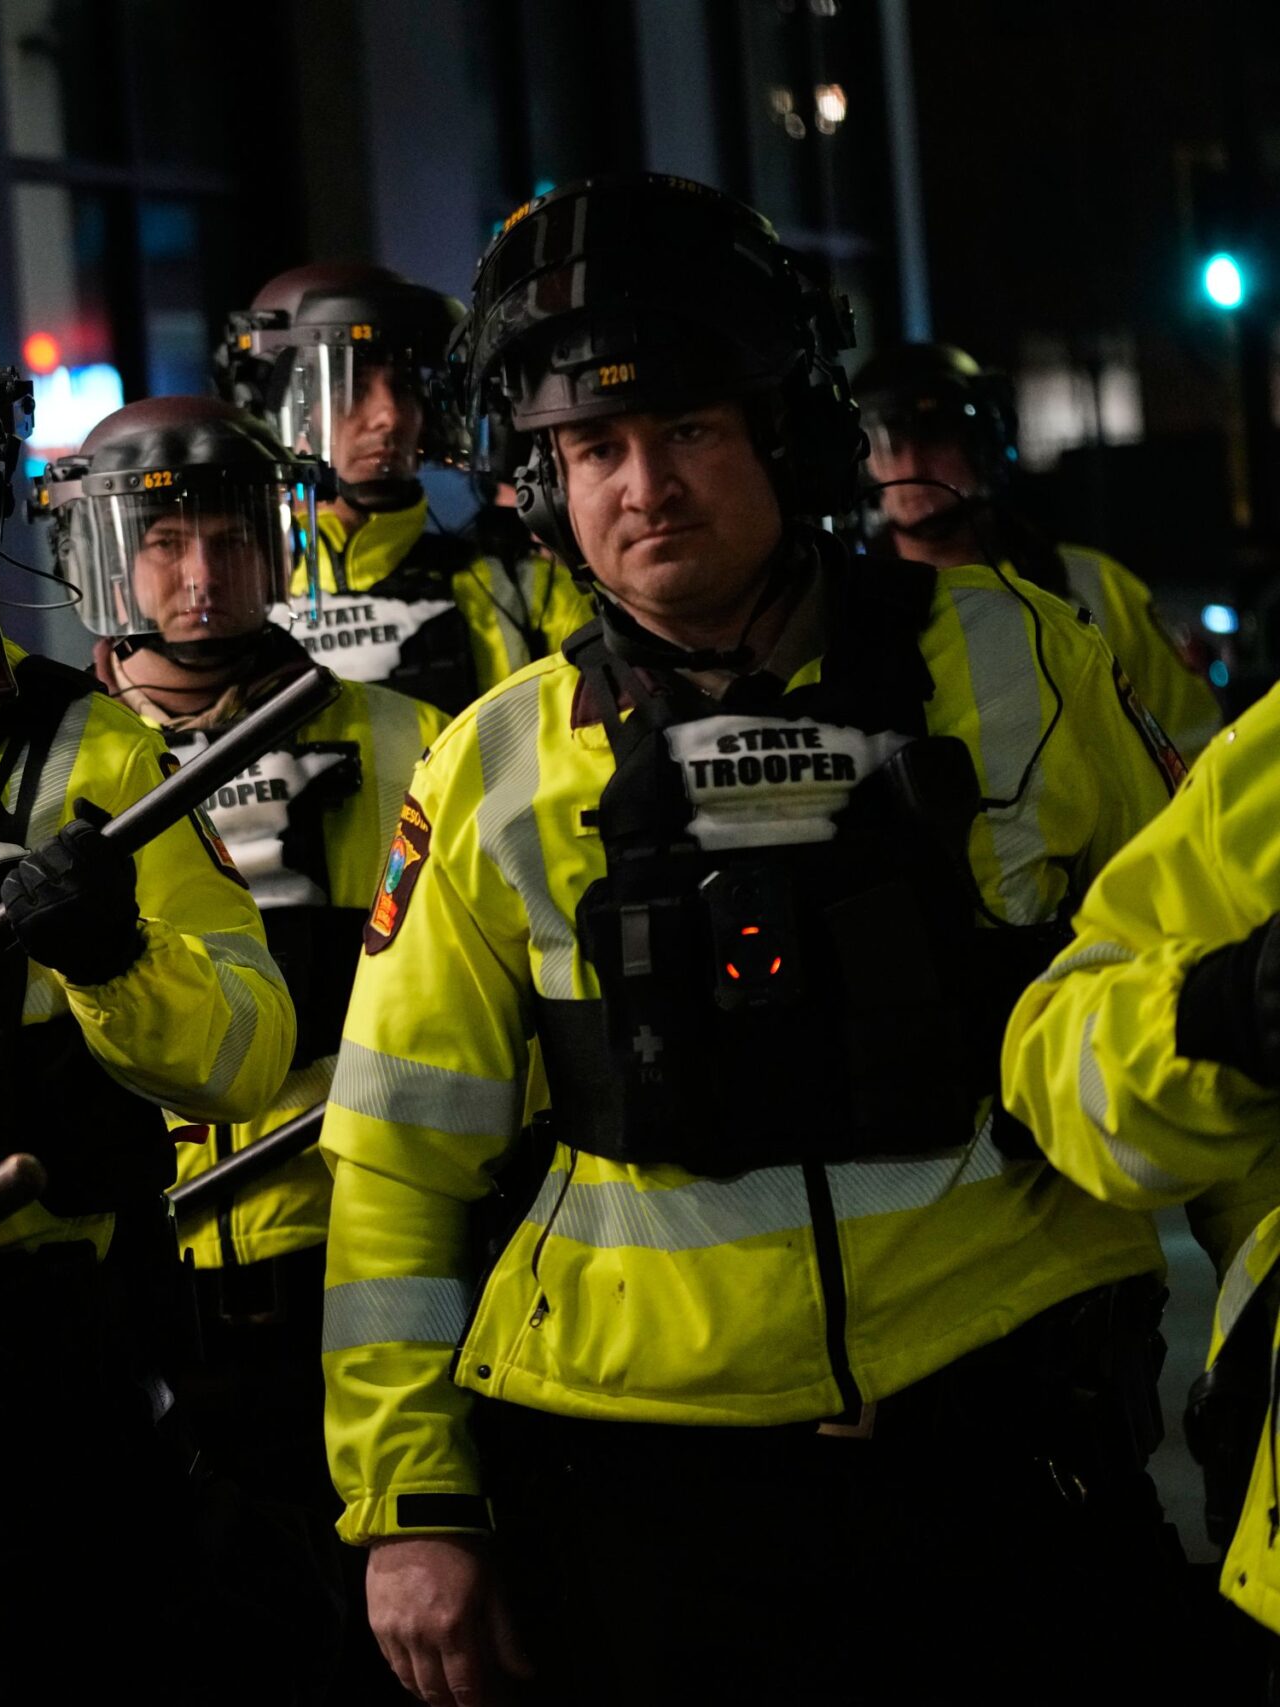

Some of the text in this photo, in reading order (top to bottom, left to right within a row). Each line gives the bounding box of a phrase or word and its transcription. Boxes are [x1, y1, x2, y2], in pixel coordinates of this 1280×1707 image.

[599, 361, 637, 386] 2201
[144, 470, 174, 489] 622
[303, 624, 400, 654] ROOPER
[716, 727, 822, 755] STATE
[688, 753, 856, 789] TROOPER
[204, 779, 289, 811] OOPER
